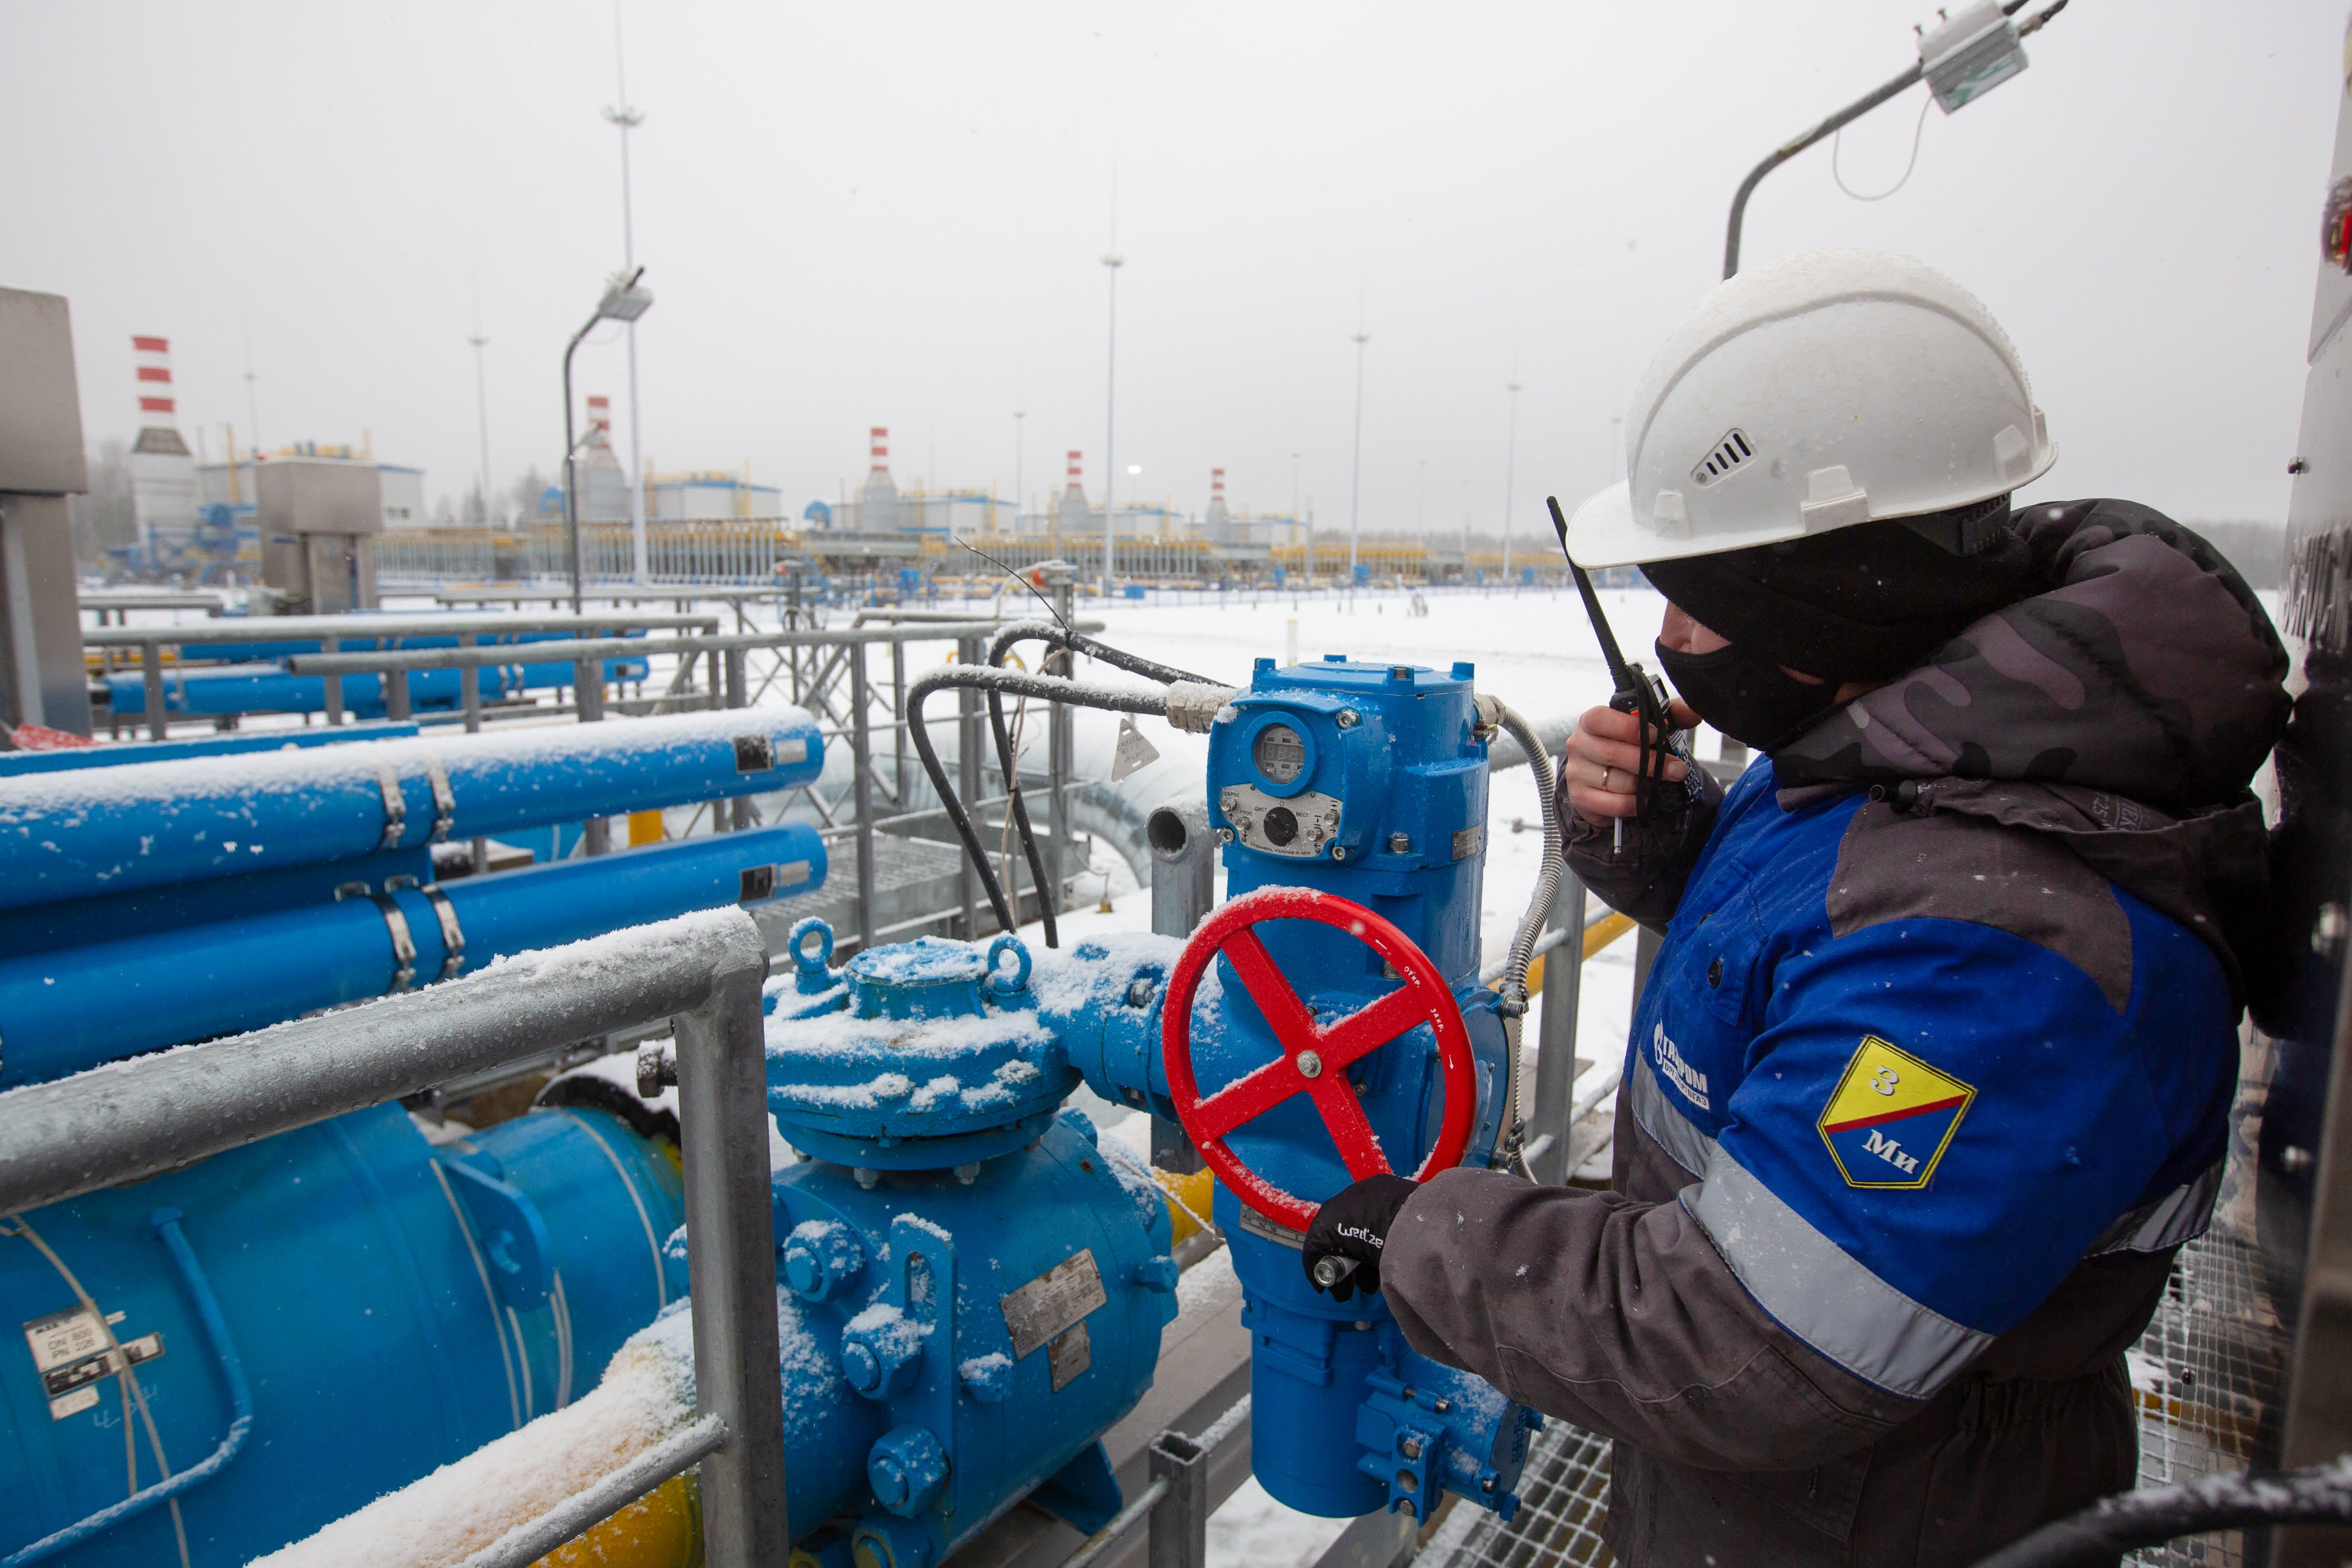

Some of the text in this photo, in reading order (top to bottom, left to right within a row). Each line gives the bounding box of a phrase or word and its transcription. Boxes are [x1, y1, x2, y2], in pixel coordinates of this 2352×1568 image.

[1404, 966, 1421, 988] ОТКР.
[1429, 1007, 1445, 1032] ЗАКР.
[1862, 1129, 1921, 1175] Ми
